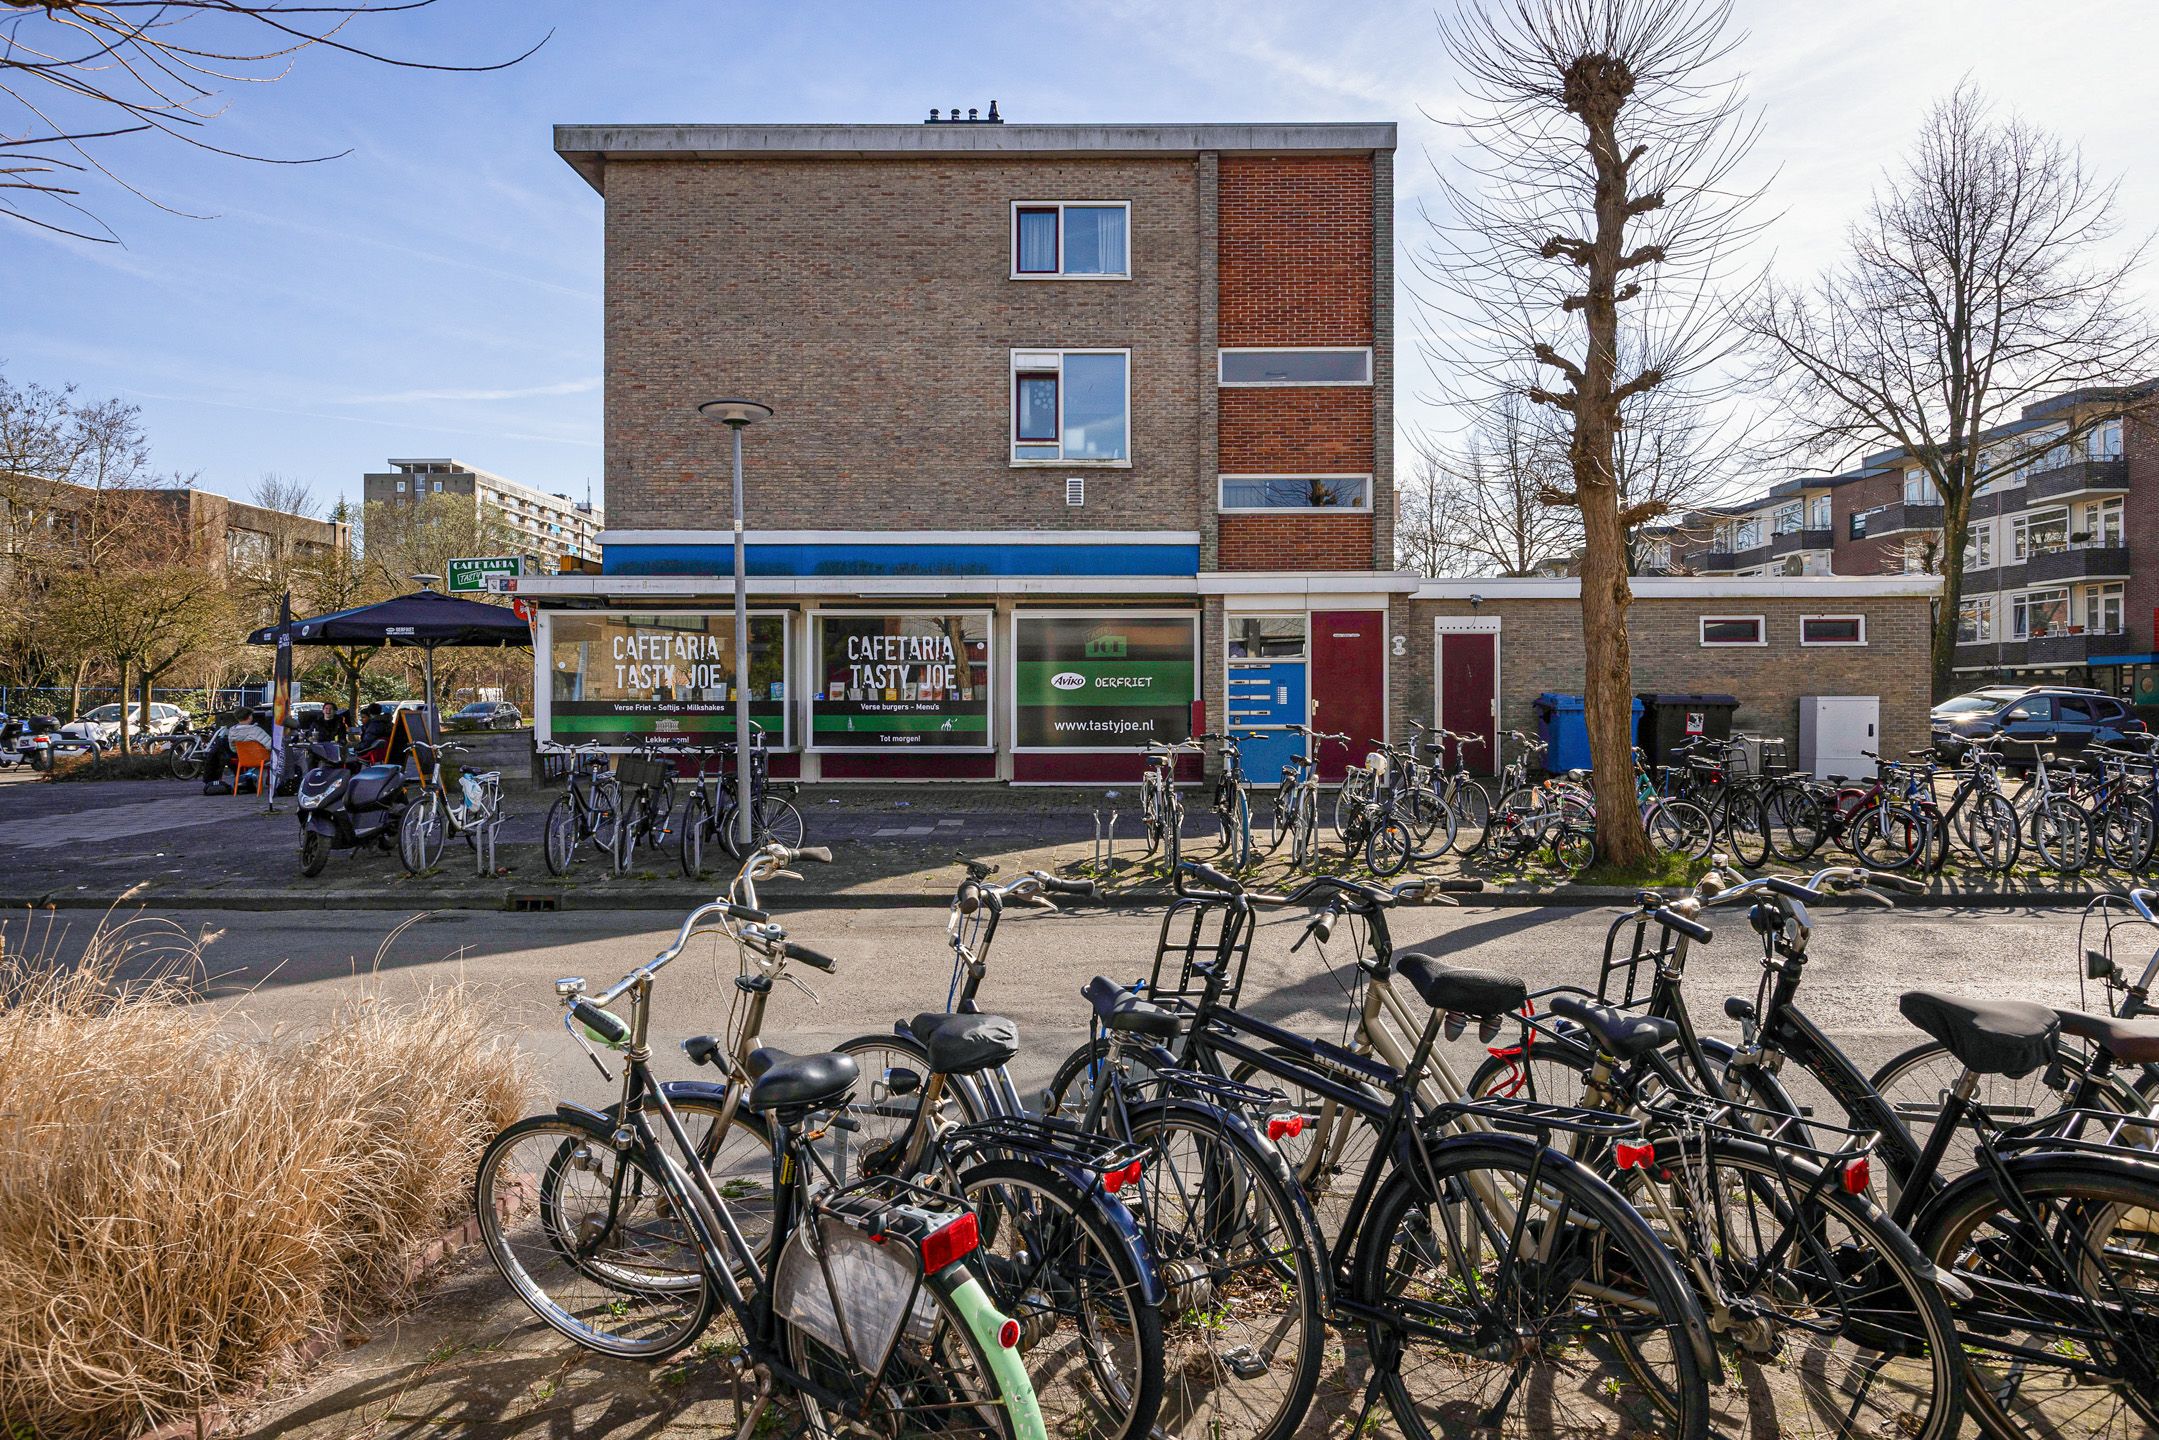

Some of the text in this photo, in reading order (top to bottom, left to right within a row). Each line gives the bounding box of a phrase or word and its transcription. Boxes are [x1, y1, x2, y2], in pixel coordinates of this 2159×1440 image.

[453, 560, 515, 570] CAFETARIA
[460, 572, 481, 583] TASTY
[613, 635, 720, 661] CAFETARIA
[847, 635, 955, 661] CAFETARIA
[614, 664, 722, 689] TASTY JOE
[849, 664, 957, 689] TASTY JOE
[1094, 676, 1153, 688] OERFRIET
[614, 703, 634, 711] Verse
[635, 703, 652, 711] Friet
[658, 703, 680, 713] Softijs
[687, 703, 725, 711] Milkshakes
[860, 703, 881, 711] Verse
[882, 703, 909, 712] burgers
[916, 703, 940, 711] Menu's
[1054, 719, 1155, 734] www.tastyjoe.nl
[893, 735, 921, 743] morgen!
